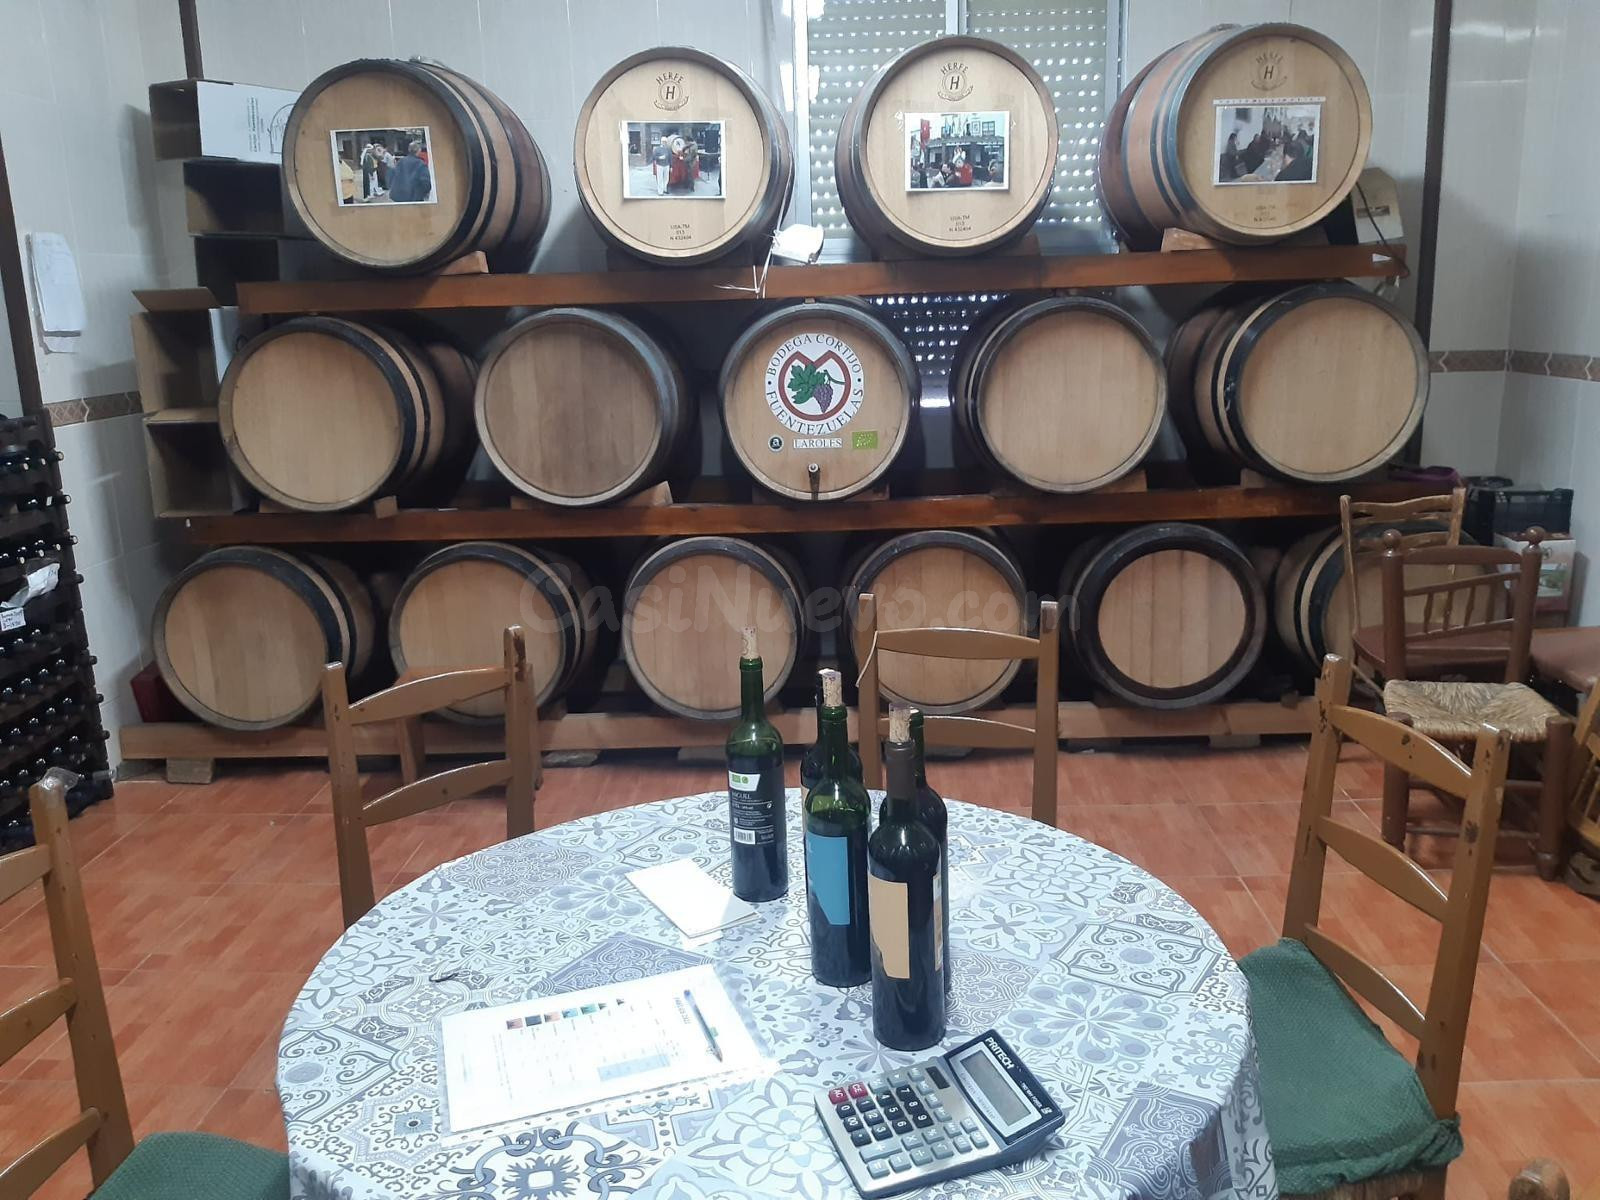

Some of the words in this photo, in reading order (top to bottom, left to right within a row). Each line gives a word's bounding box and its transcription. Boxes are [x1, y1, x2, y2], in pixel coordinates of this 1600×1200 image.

[1263, 65, 1274, 80] H
[949, 75, 960, 90] H
[665, 85, 676, 100] H
[767, 335, 812, 376] BODEGA
[816, 334, 862, 374] CORTIJO
[766, 389, 863, 434] FUENTEZUELAS
[985, 1036, 1015, 1069] PRITECH
[832, 1089, 844, 1098] AC
[852, 1083, 862, 1094] CE
